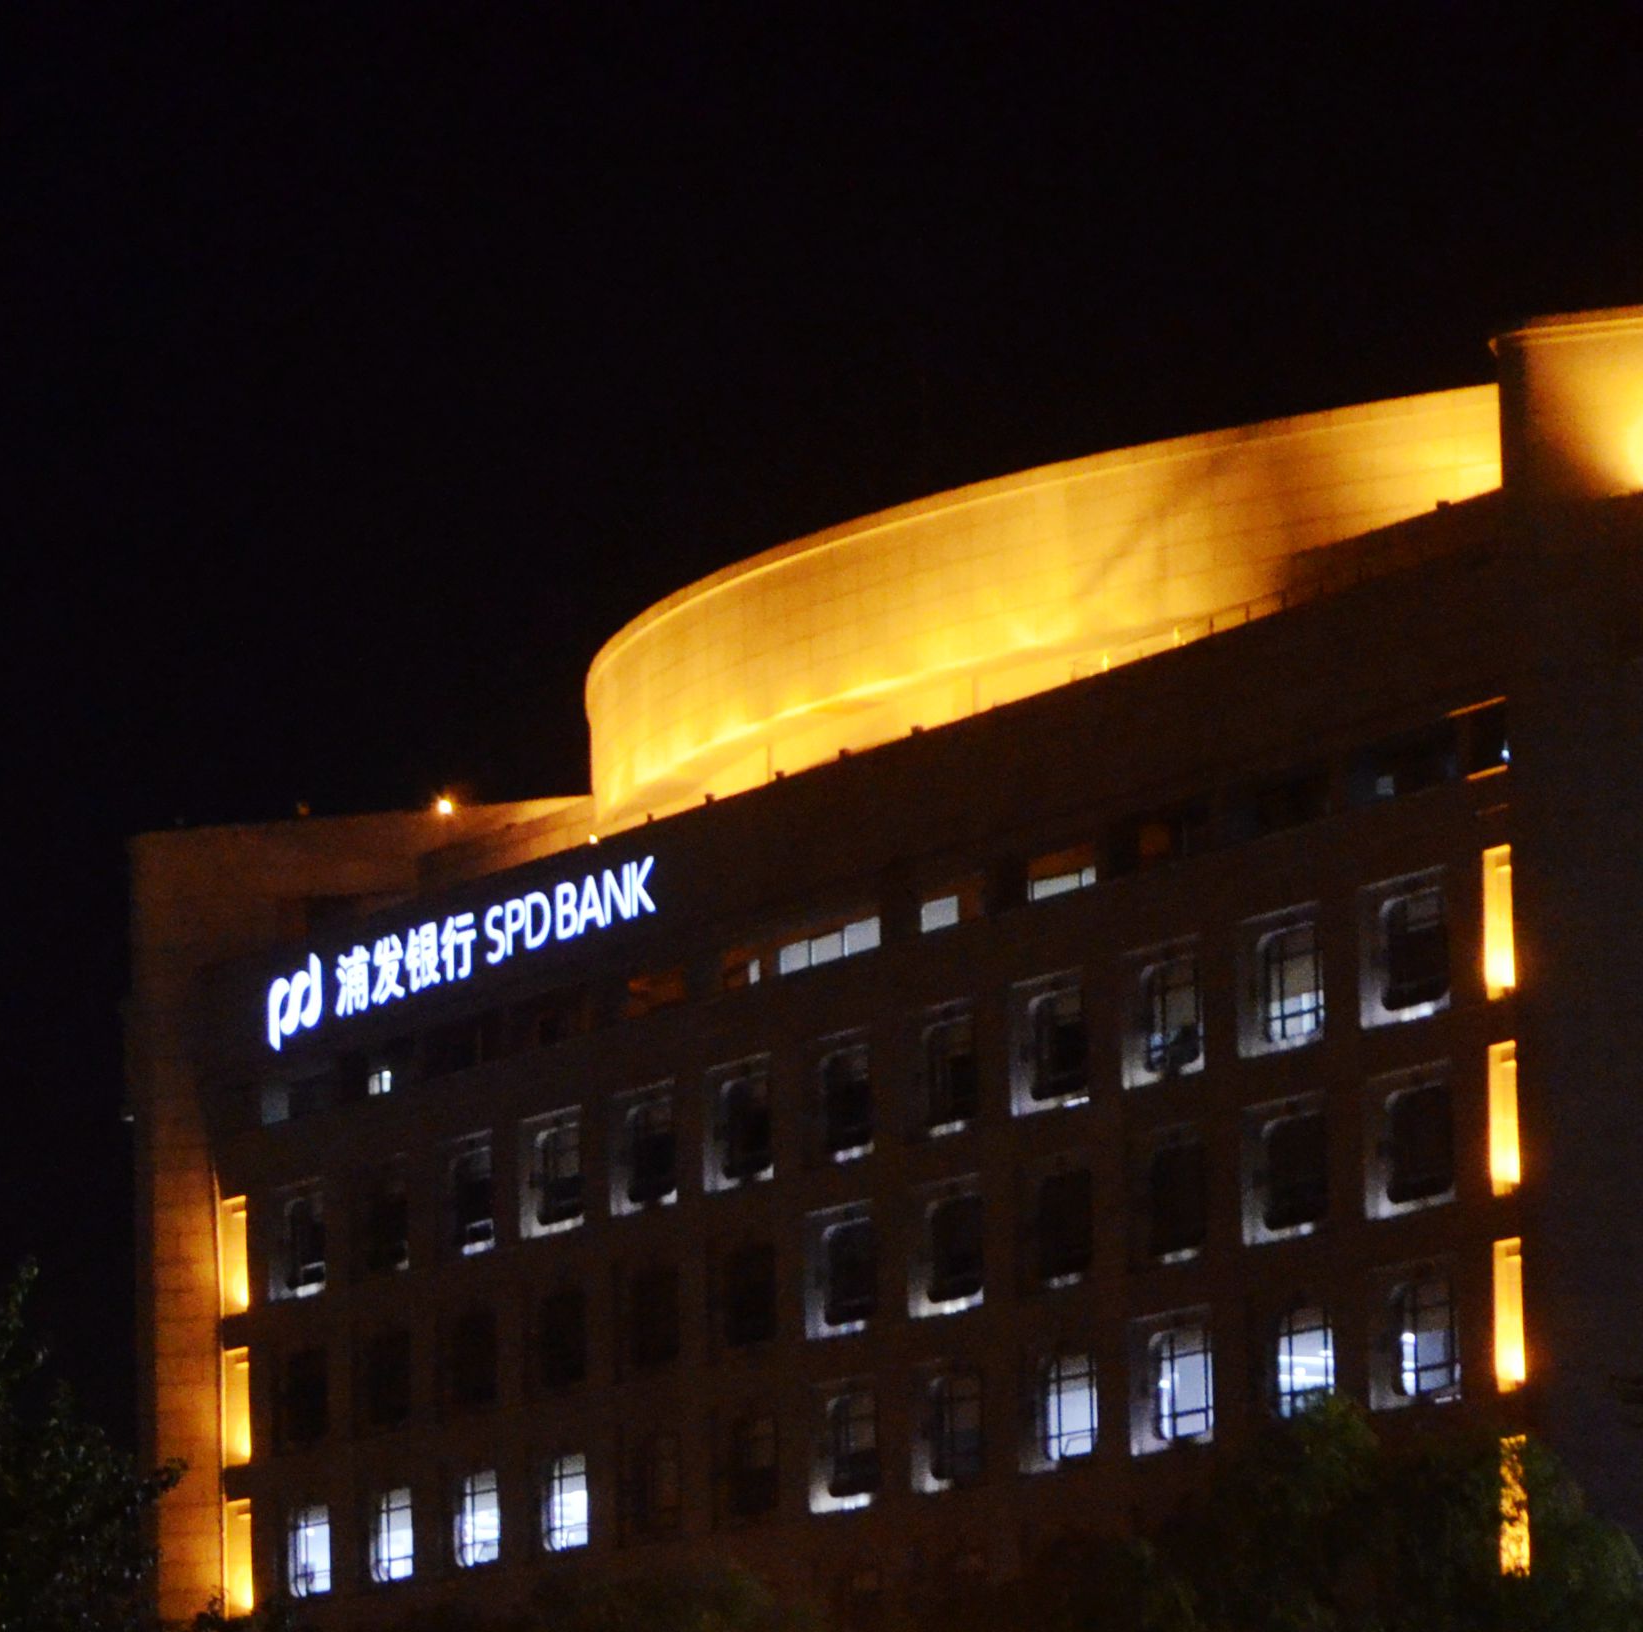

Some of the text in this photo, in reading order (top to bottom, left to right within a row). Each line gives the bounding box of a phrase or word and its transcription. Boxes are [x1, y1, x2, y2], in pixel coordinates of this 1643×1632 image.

[334, 855, 657, 1018] 浦发银行 SPD BANK
